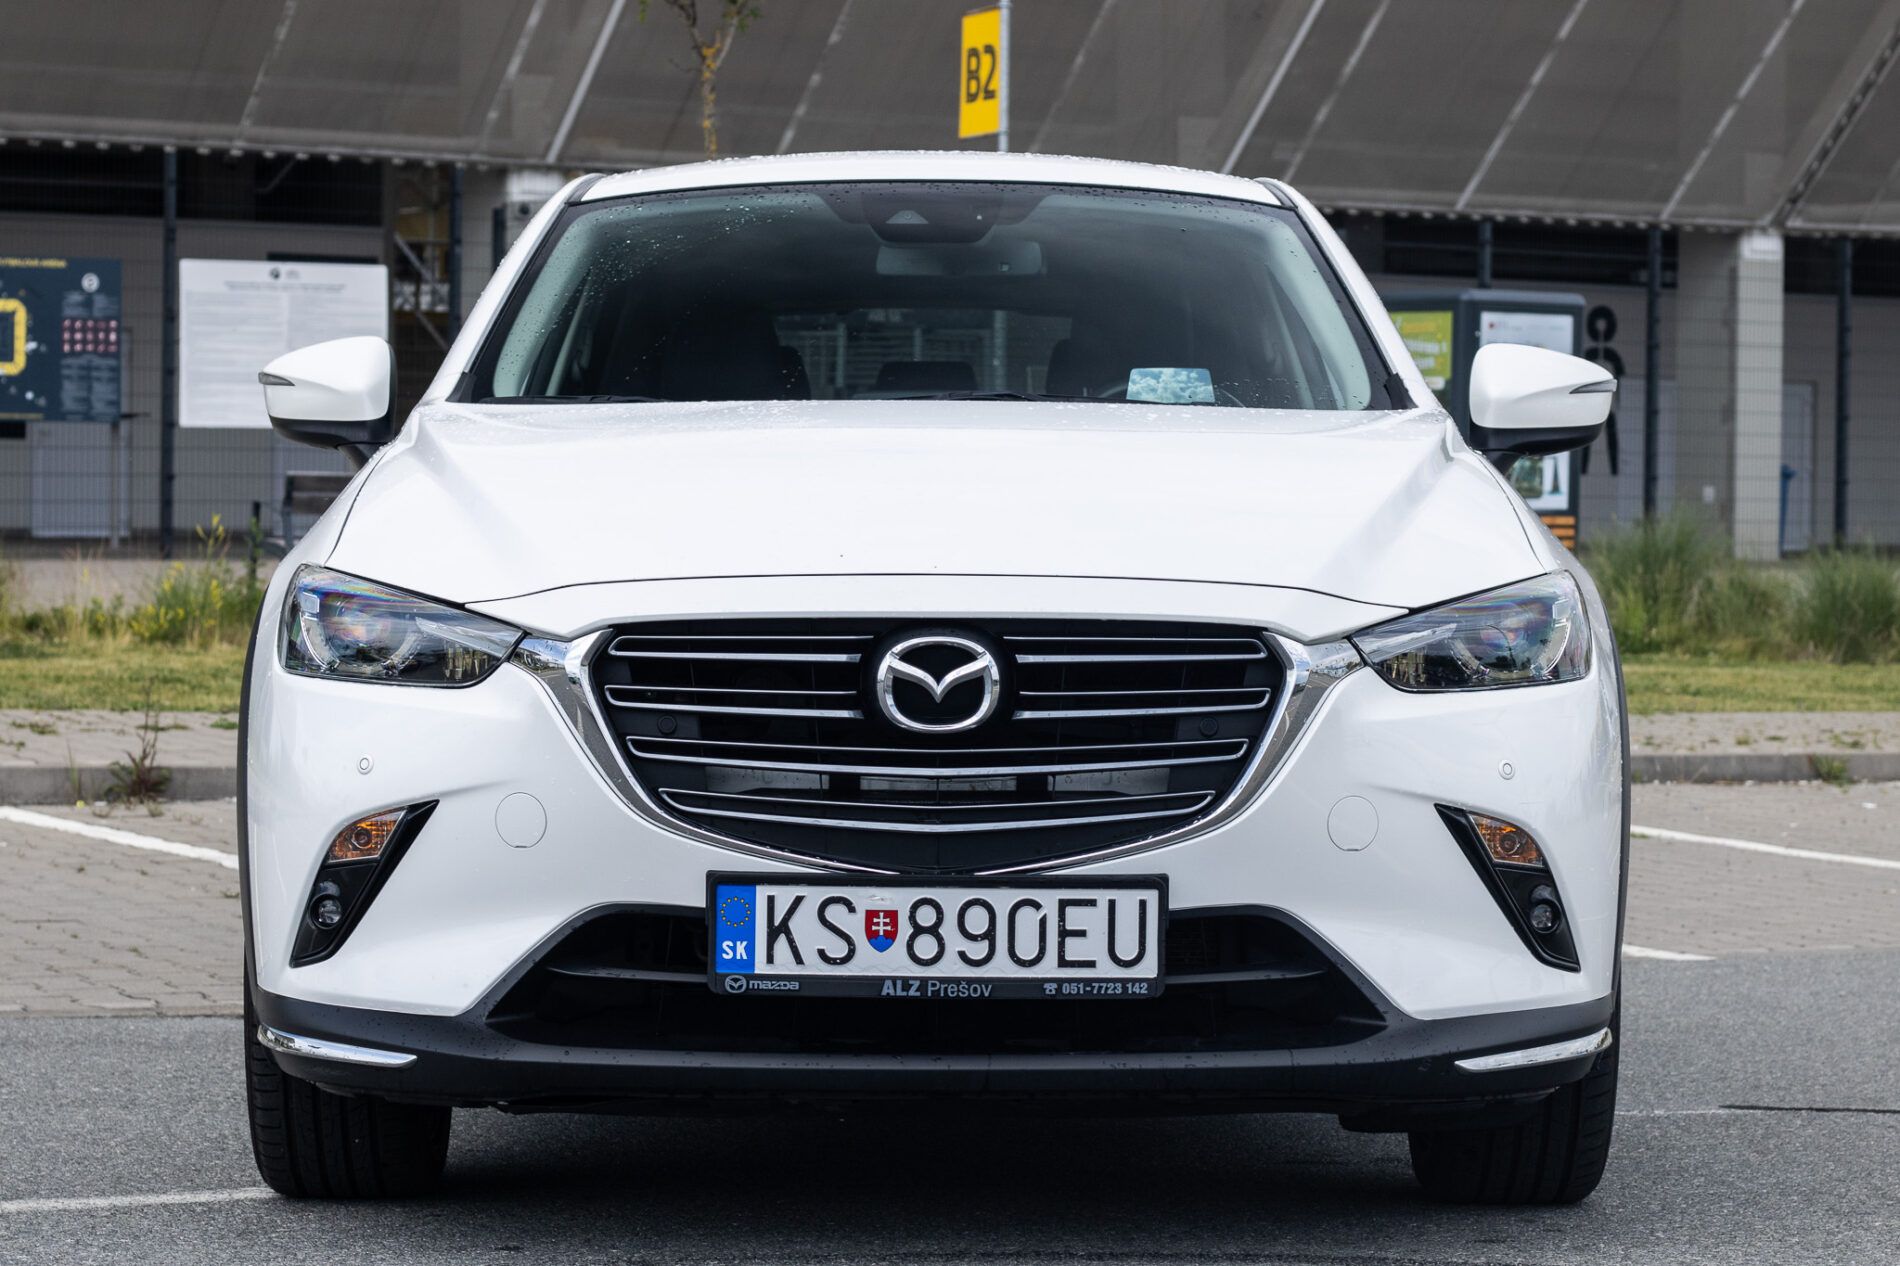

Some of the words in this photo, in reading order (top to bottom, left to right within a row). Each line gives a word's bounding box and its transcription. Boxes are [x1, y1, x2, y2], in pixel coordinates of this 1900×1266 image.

[966, 44, 996, 103] B2
[766, 895, 857, 966] KS
[906, 897, 1148, 968] 890EU
[722, 940, 748, 960] SK
[881, 980, 921, 997] ALZ
[927, 980, 993, 998] Prešov
[1062, 983, 1123, 995] 051-7723
[1126, 983, 1149, 995] 142
